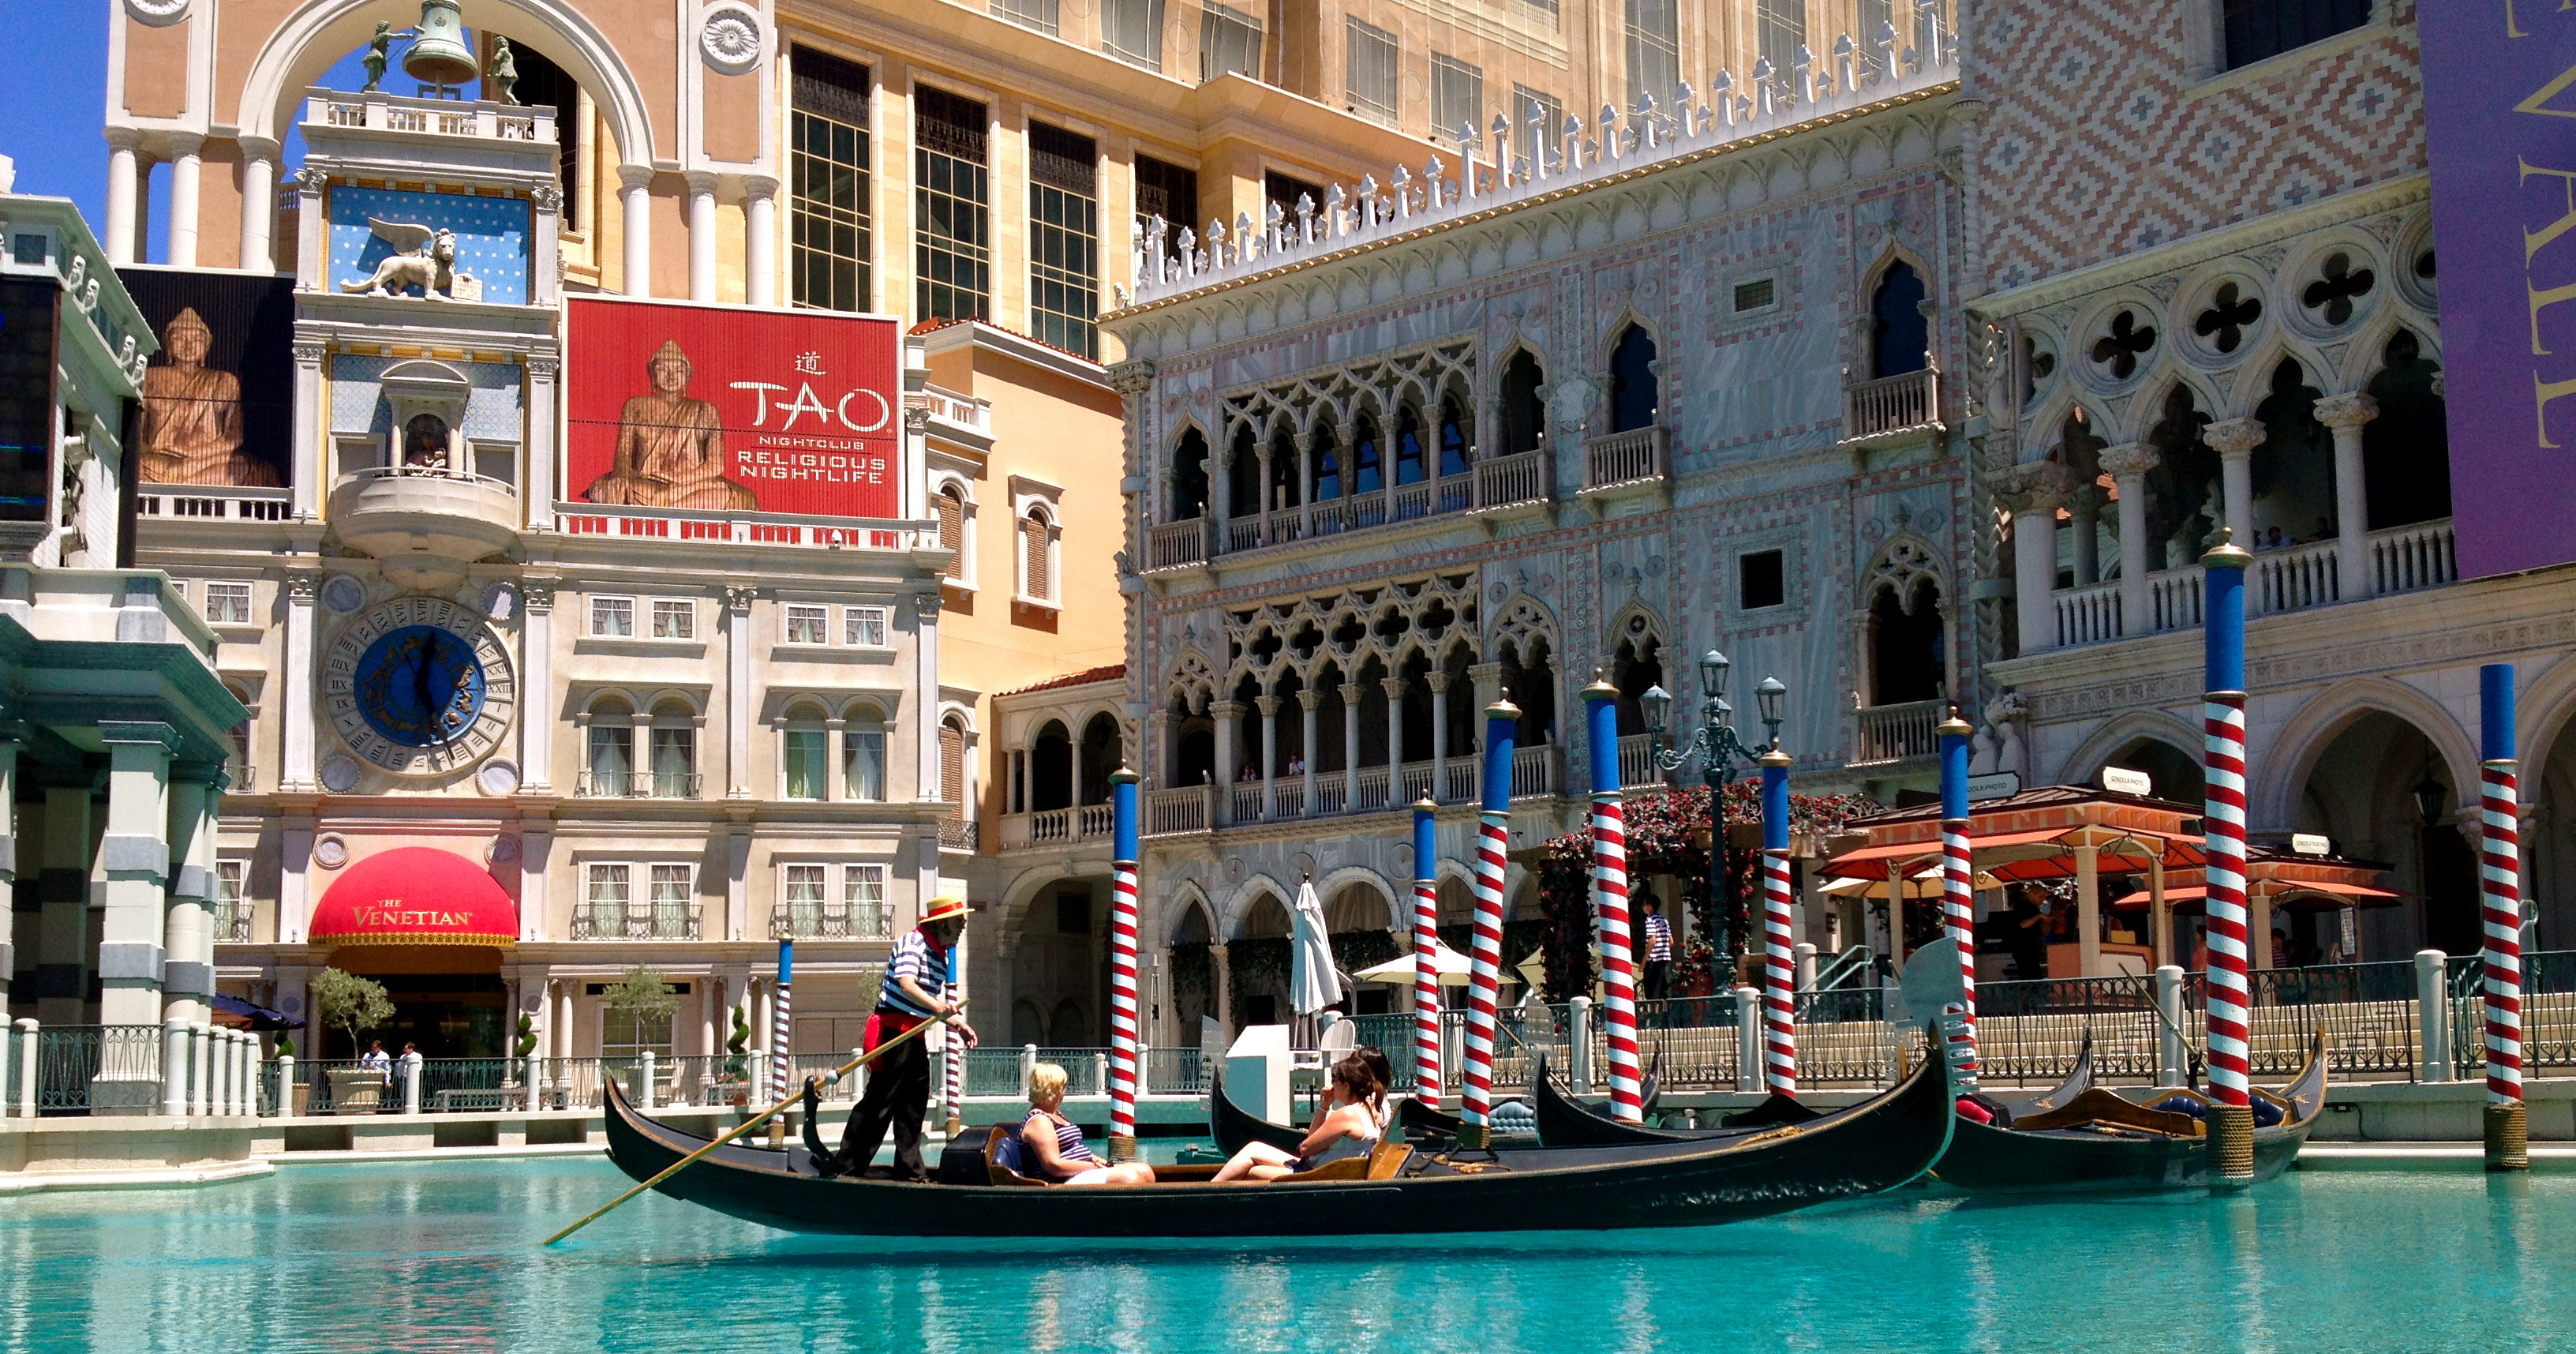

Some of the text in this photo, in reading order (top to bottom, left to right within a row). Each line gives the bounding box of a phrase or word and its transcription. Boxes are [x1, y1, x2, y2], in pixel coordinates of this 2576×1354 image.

[795, 351, 827, 376] 道
[729, 381, 889, 433] TAO
[759, 436, 864, 450] NIGHTCLUB
[738, 451, 886, 471] RELIGIOUS
[740, 465, 882, 484] NIGHTLIFE
[377, 899, 402, 908] THE
[353, 906, 469, 927] VENETIAN
